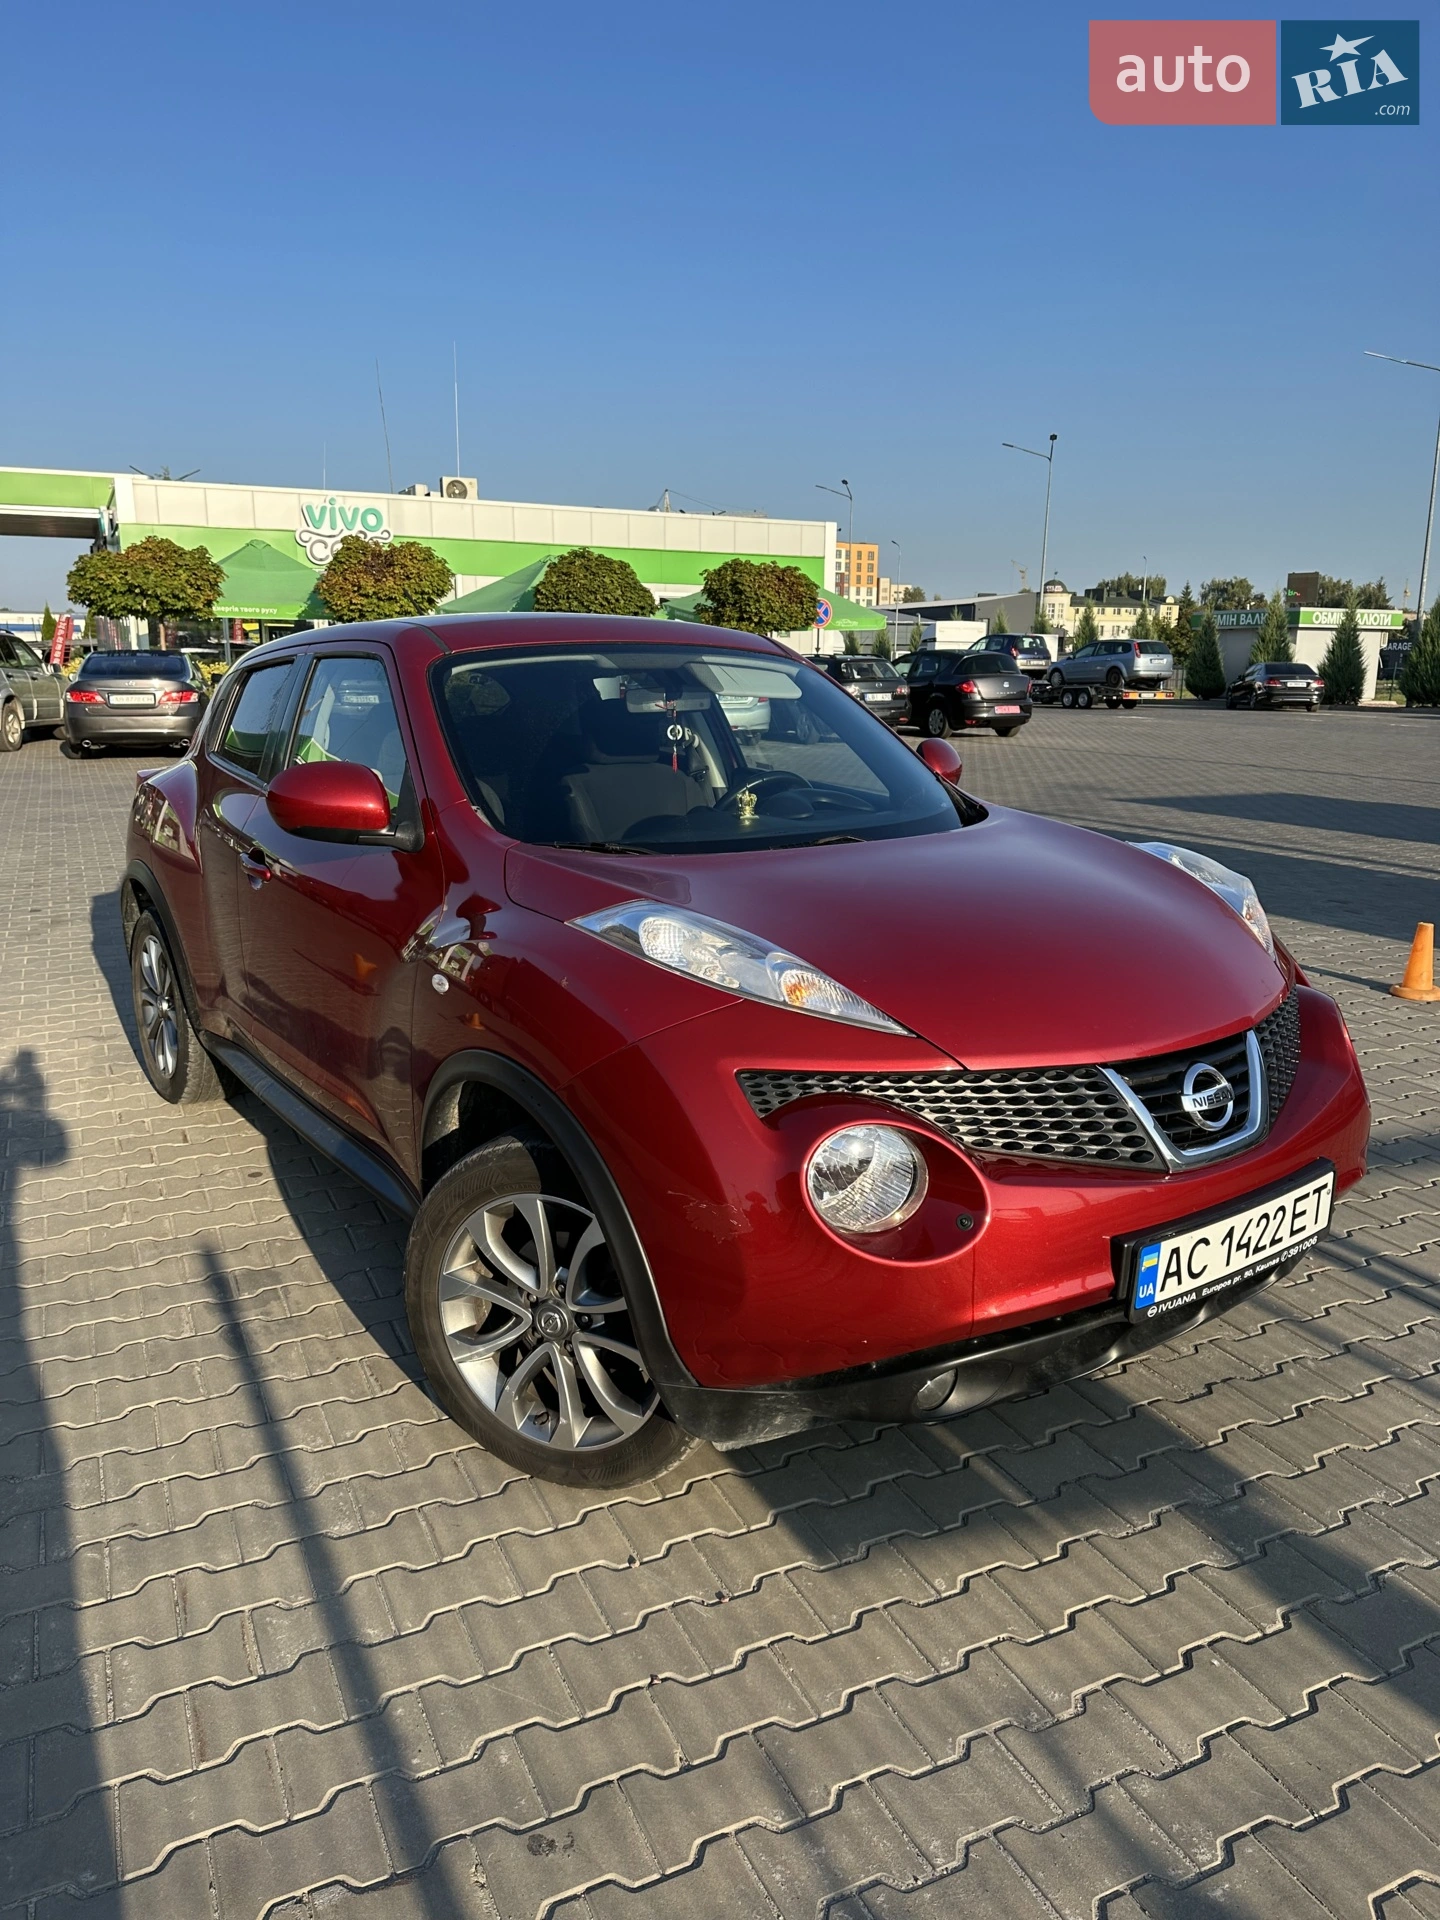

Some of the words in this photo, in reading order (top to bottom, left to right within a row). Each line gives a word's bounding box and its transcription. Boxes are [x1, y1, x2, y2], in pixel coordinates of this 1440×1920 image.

[305, 497, 384, 532] vivo
[1213, 614, 1237, 625] БМІН
[1356, 613, 1392, 626] АЛЮТИ
[1192, 1088, 1233, 1108] NISSAN
[1159, 1237, 1211, 1293] AC
[1139, 1284, 1154, 1298] UA
[1202, 1279, 1232, 1296] Europos
